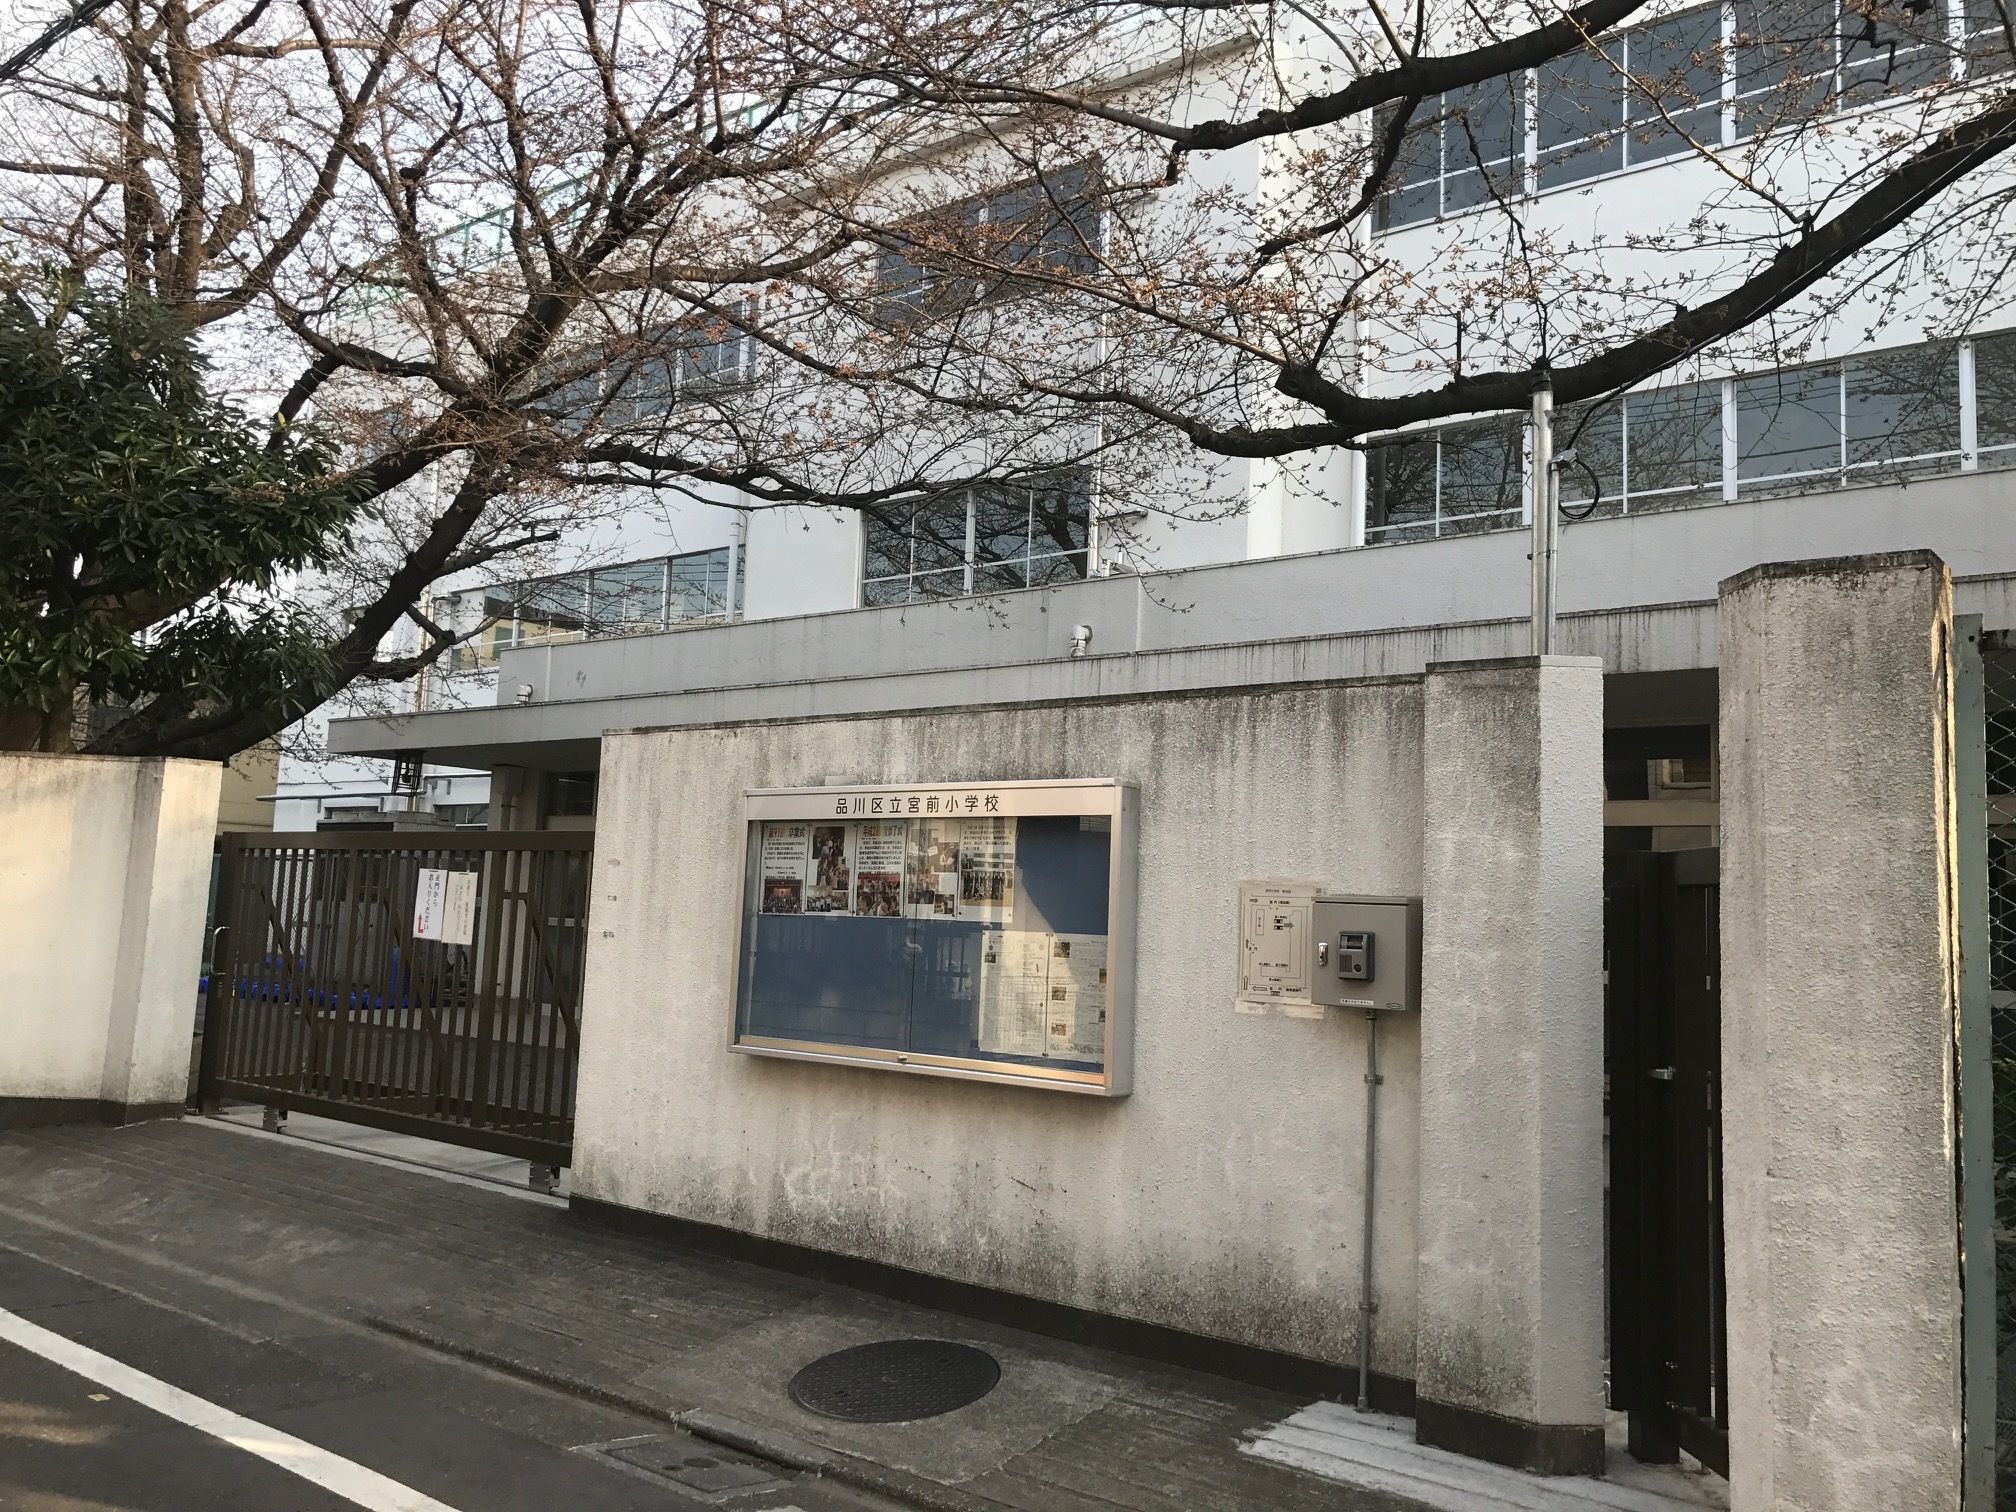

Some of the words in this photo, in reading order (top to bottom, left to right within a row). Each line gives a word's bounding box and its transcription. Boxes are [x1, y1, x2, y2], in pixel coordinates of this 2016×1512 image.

[836, 794, 999, 814] 品川区立宮前小学校
[424, 874, 434, 930] お入りください
